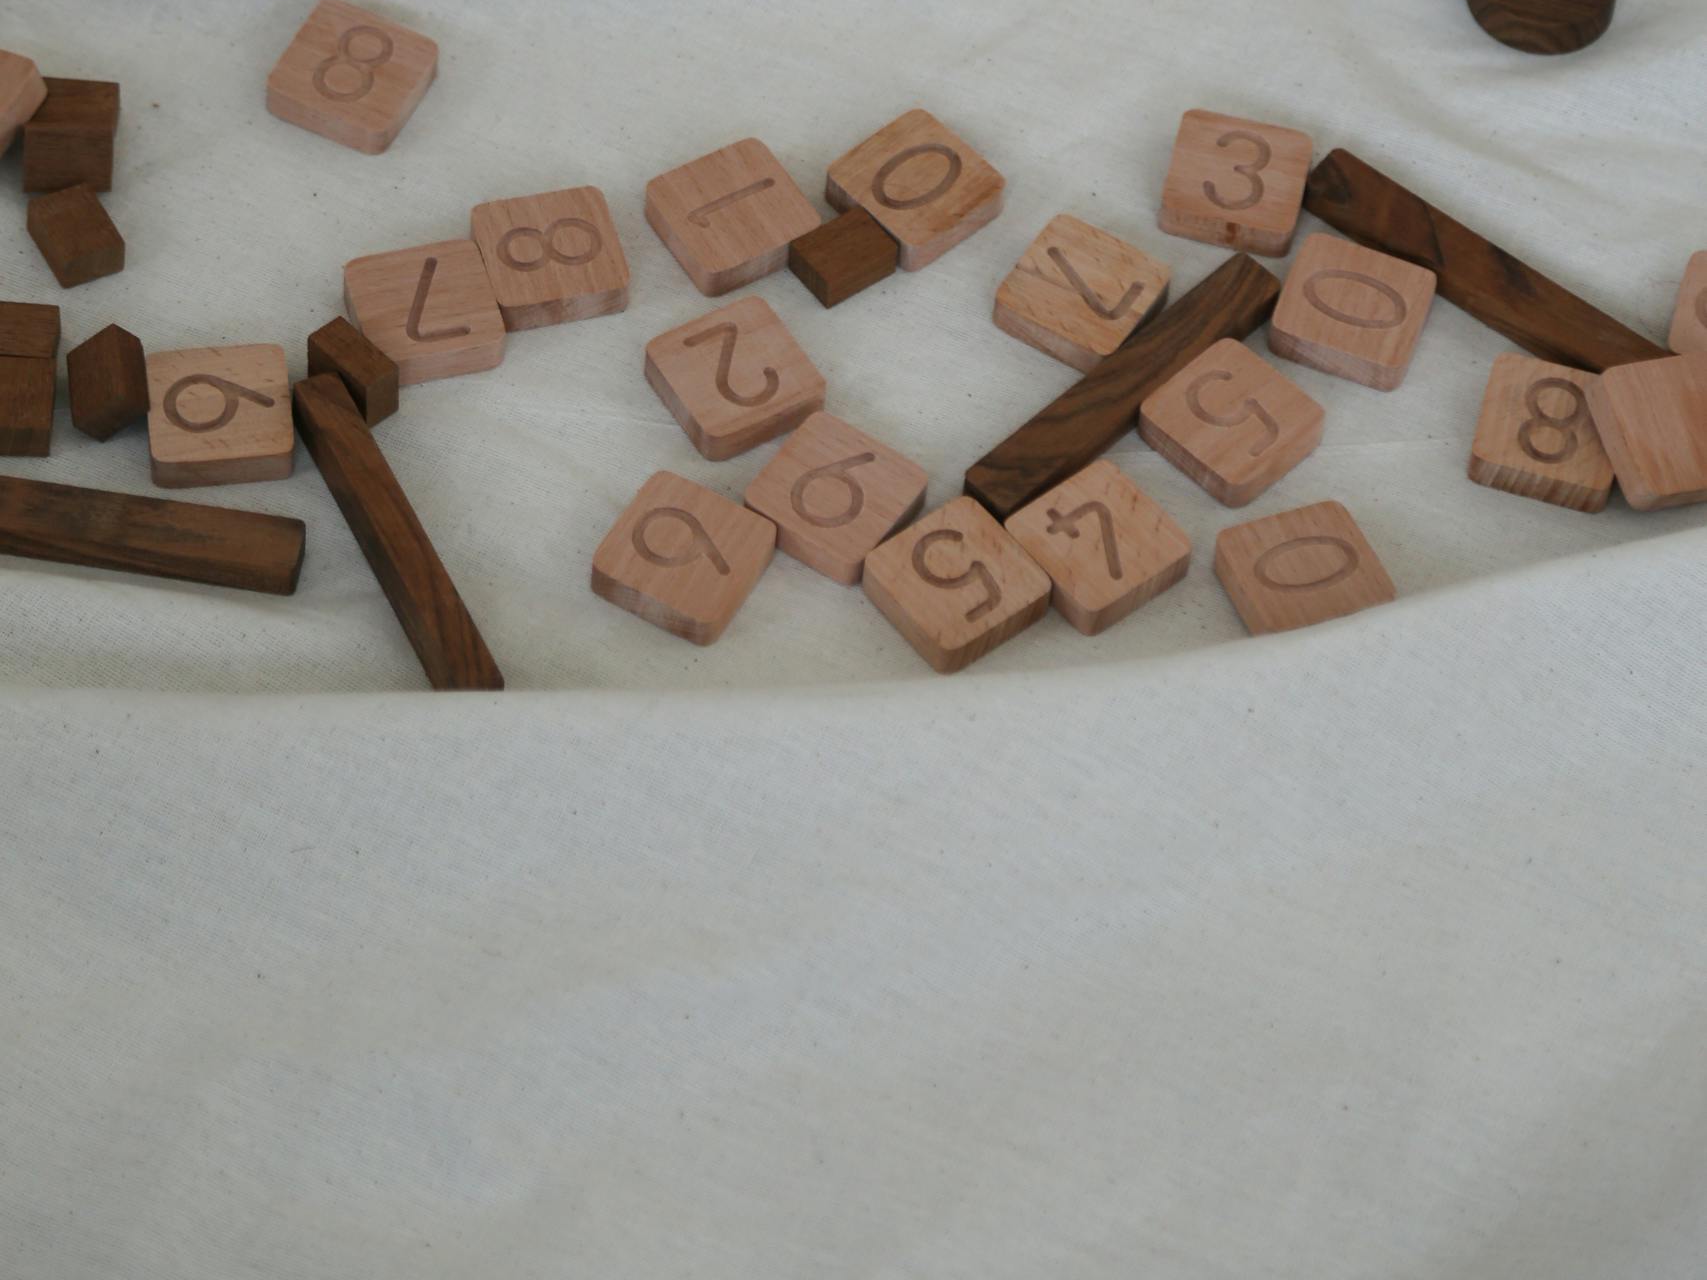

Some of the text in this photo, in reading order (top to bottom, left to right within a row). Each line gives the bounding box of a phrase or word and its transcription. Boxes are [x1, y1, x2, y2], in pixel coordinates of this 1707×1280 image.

[311, 24, 394, 102] 8
[687, 177, 775, 228] 1
[870, 142, 963, 210] 0
[1203, 131, 1271, 210] 3
[496, 217, 602, 273] 8
[1047, 245, 1146, 321] 7
[405, 256, 472, 343] 7
[1302, 269, 1408, 329] 0
[682, 322, 780, 408] 2
[1184, 368, 1280, 459] 5
[1516, 376, 1587, 463] 8
[911, 528, 1002, 624] 5
[1045, 500, 1124, 581] 4
[1253, 535, 1360, 594] 0
